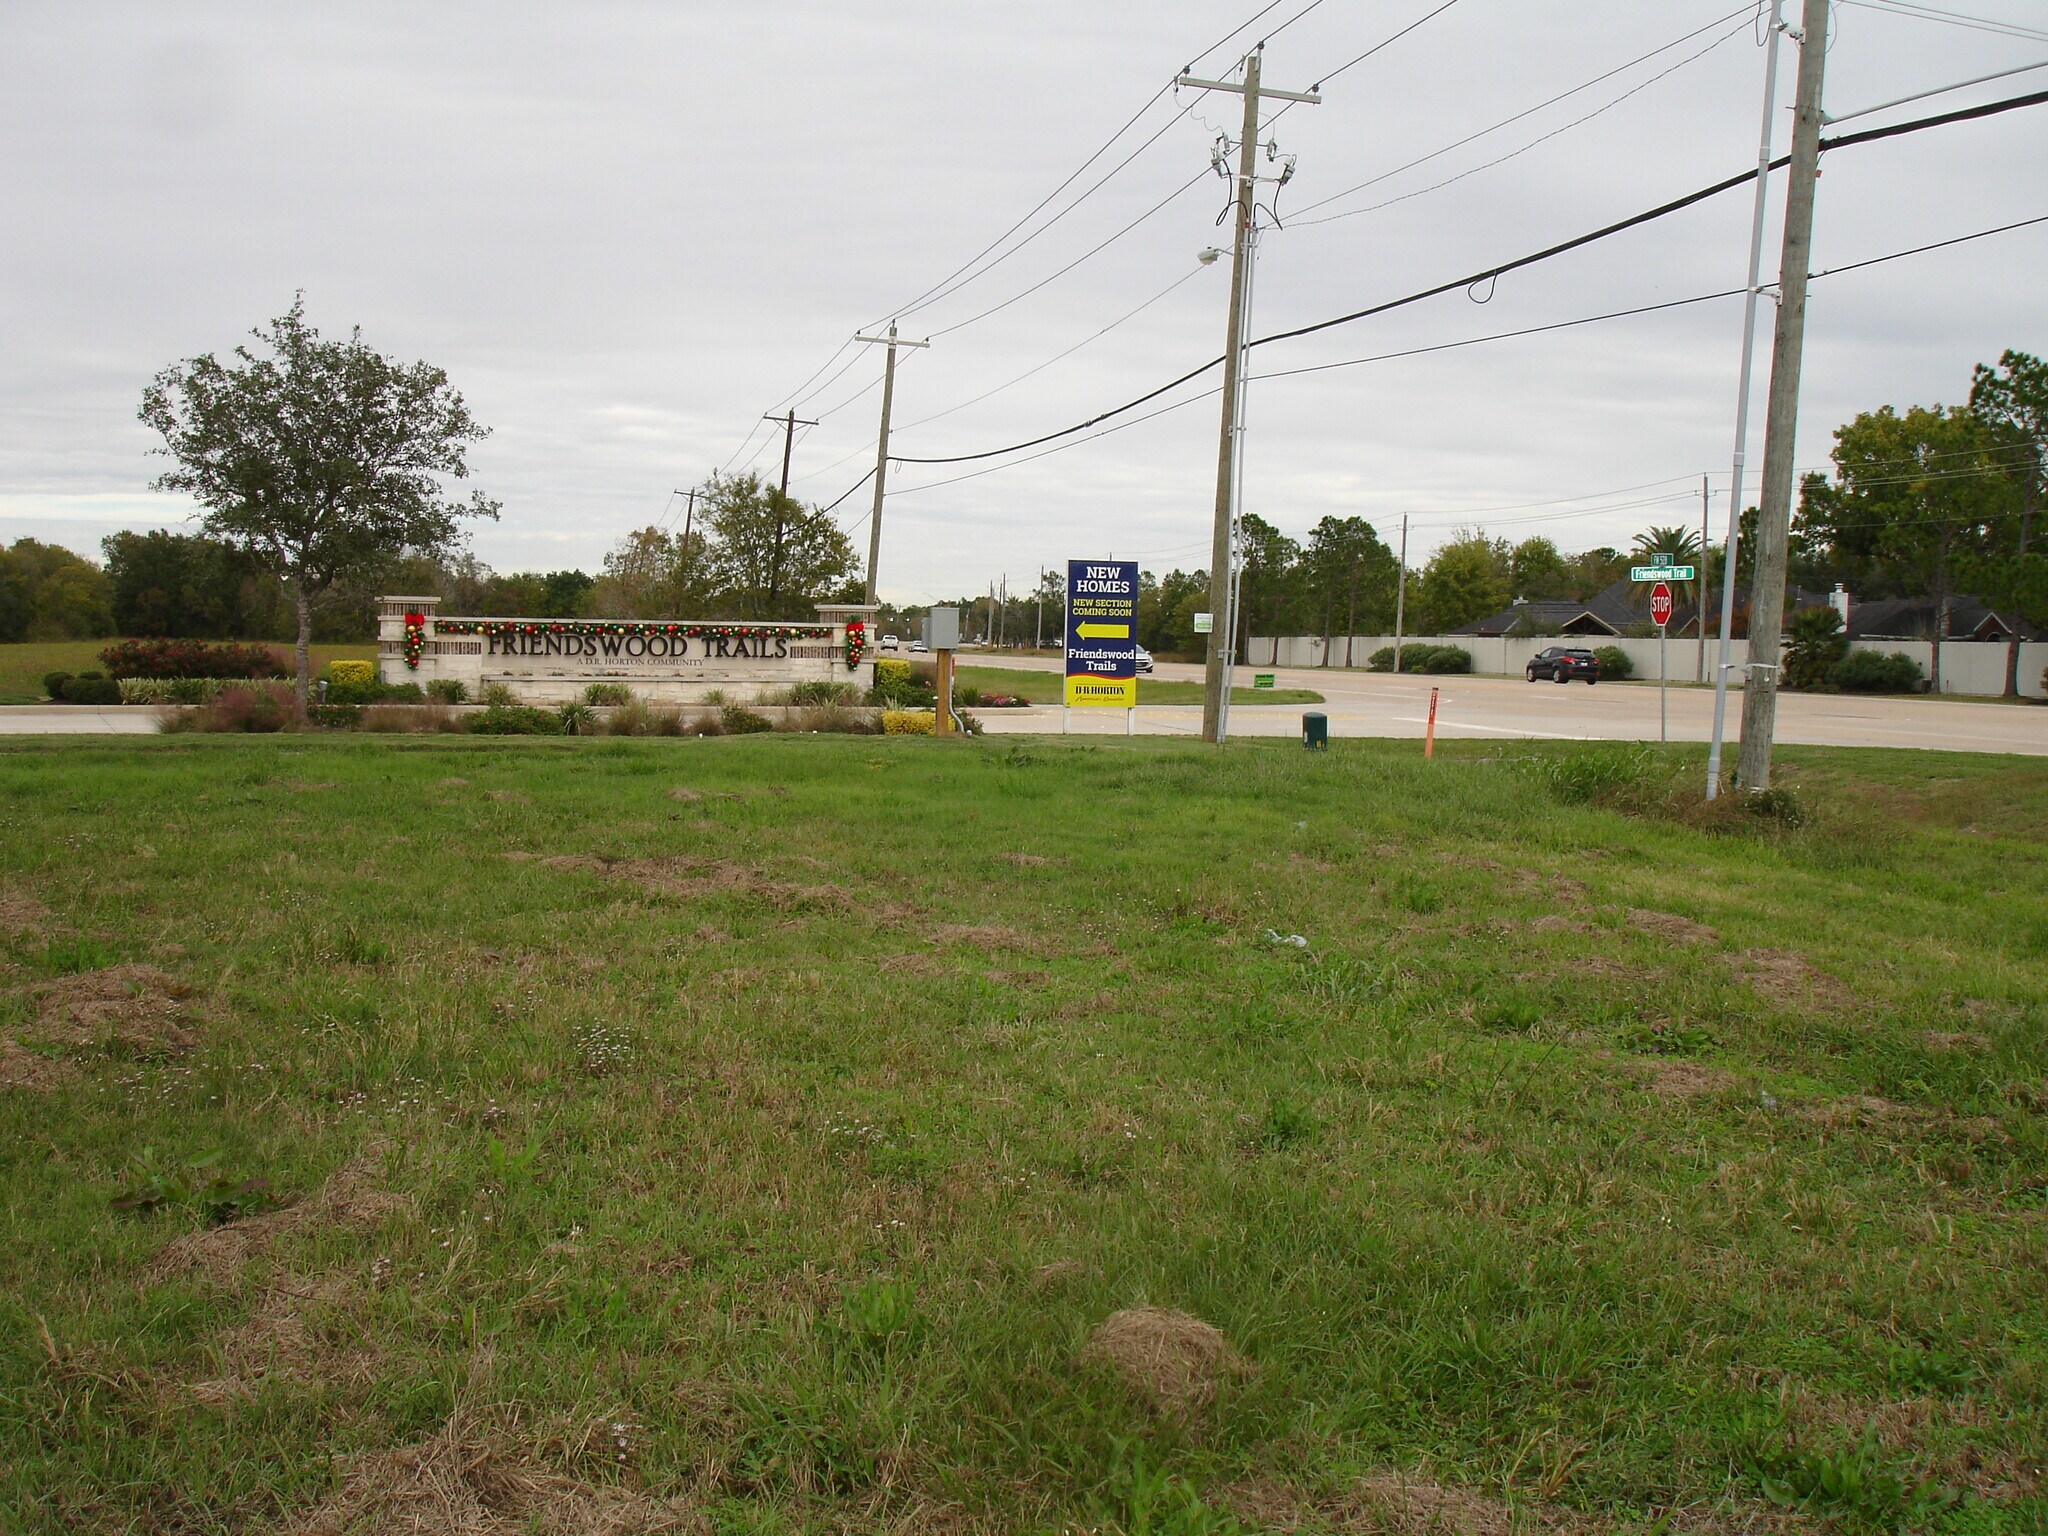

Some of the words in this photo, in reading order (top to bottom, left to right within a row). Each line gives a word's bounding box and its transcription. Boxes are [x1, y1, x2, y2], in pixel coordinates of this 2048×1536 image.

[1086, 566, 1121, 579] NEW
[1635, 568, 1672, 579] Friendswood
[1673, 568, 1687, 578] Trail
[1076, 580, 1130, 593] HOMES
[1073, 598, 1094, 607] NEW
[1095, 599, 1132, 608] SECTION
[1652, 596, 1670, 612] STOP
[1072, 607, 1107, 616] COMING
[1108, 608, 1133, 617] SOON
[487, 633, 688, 657] FRIENDSWOOD
[702, 636, 788, 659] TRAILS
[1068, 648, 1135, 660] Friendswood
[576, 657, 584, 665] A
[604, 657, 645, 666] HORTON
[647, 658, 705, 667] COMMUNITY
[1086, 660, 1117, 671] Trails
